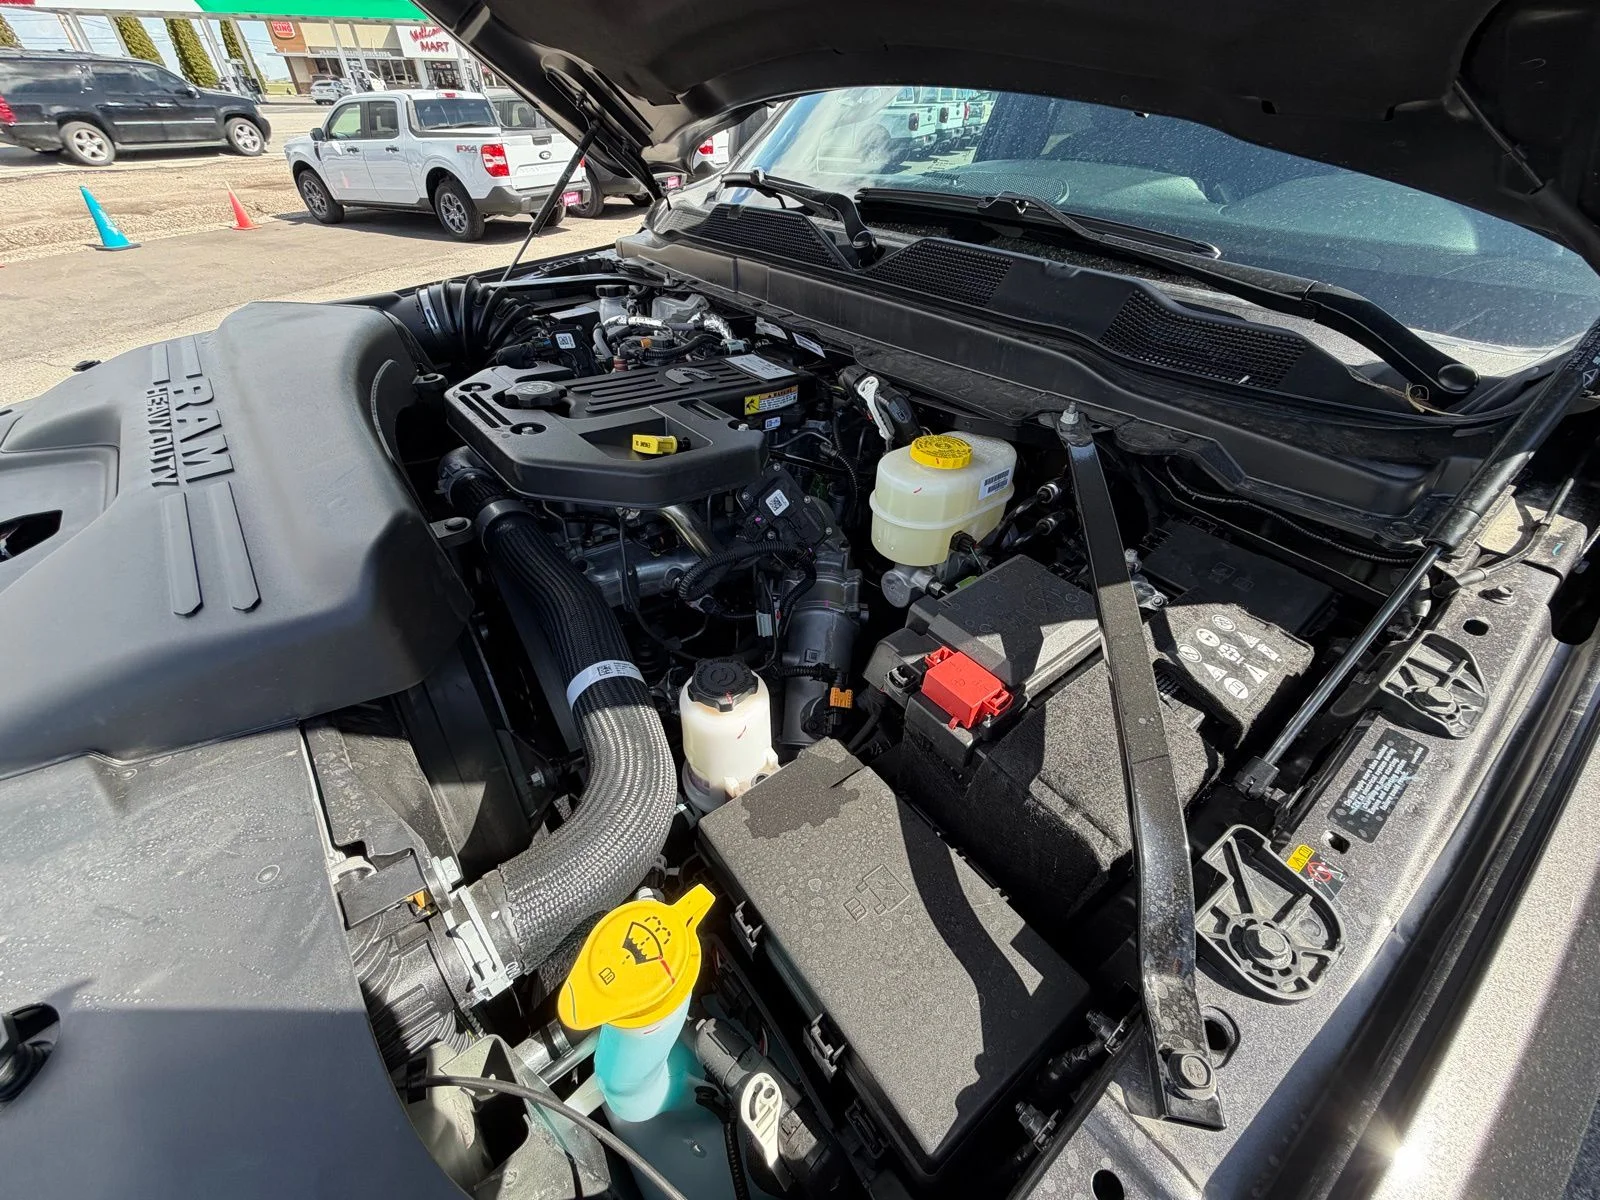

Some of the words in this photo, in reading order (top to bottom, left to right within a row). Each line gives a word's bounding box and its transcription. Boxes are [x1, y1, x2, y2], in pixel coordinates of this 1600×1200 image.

[273, 23, 293, 33] KING
[420, 41, 450, 53] MART
[456, 144, 478, 154] FX4
[146, 387, 173, 434] HEAVY
[173, 378, 235, 484] RAM
[149, 433, 180, 488] DUTY
